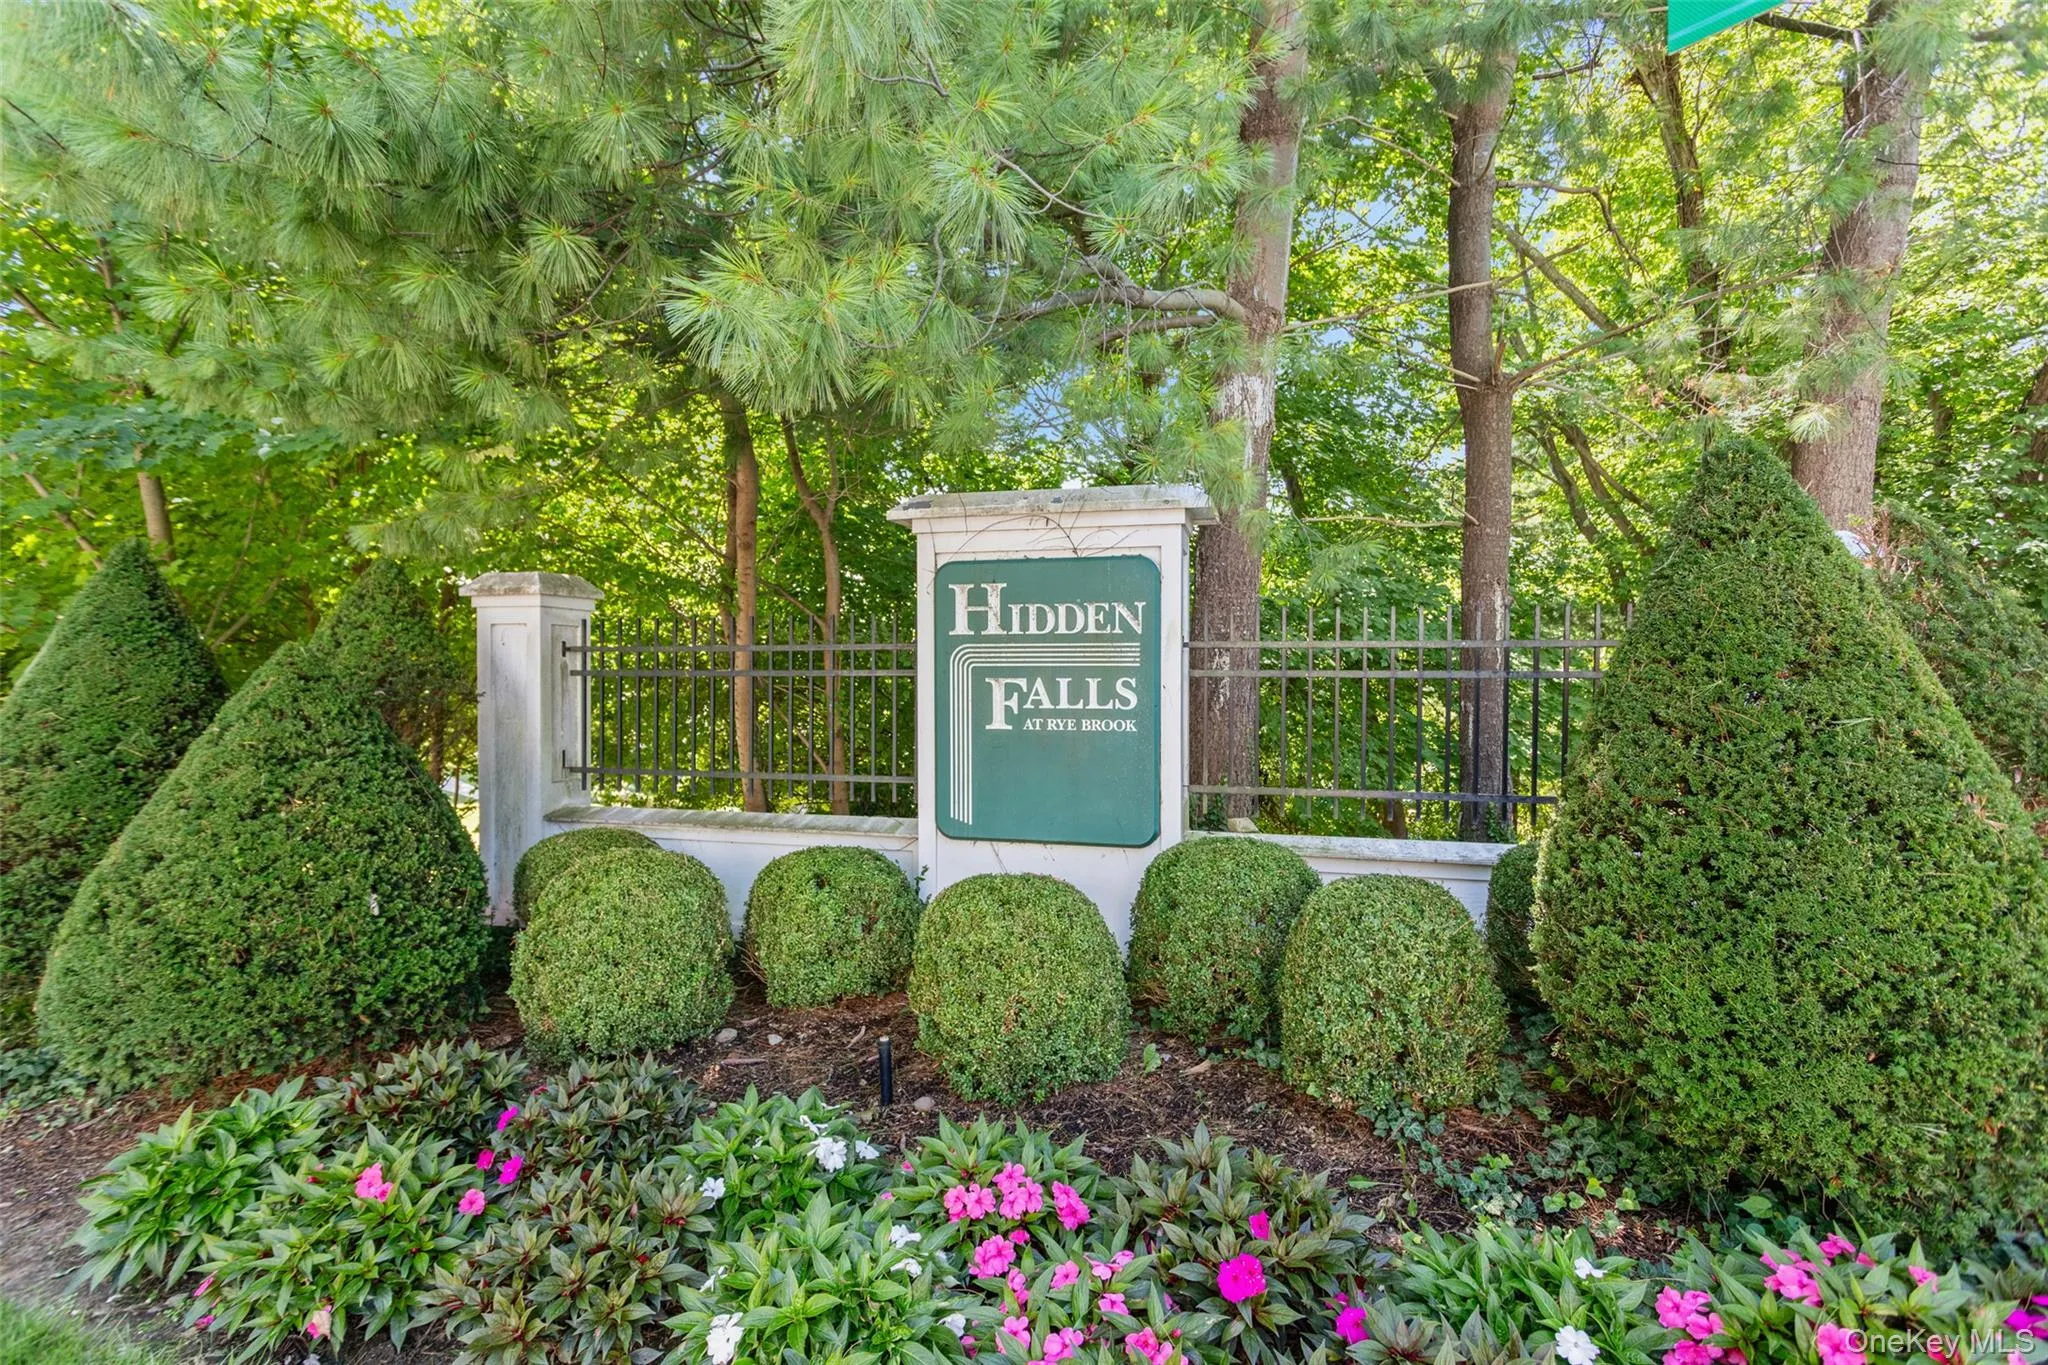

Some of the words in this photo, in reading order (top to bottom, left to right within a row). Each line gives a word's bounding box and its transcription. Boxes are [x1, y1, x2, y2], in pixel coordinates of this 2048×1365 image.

[948, 582, 1147, 635] HIDDEN
[985, 677, 1138, 730] FALLS
[1023, 718, 1044, 731] AT
[1044, 718, 1077, 731] RYE
[1081, 718, 1137, 732] BROOK
